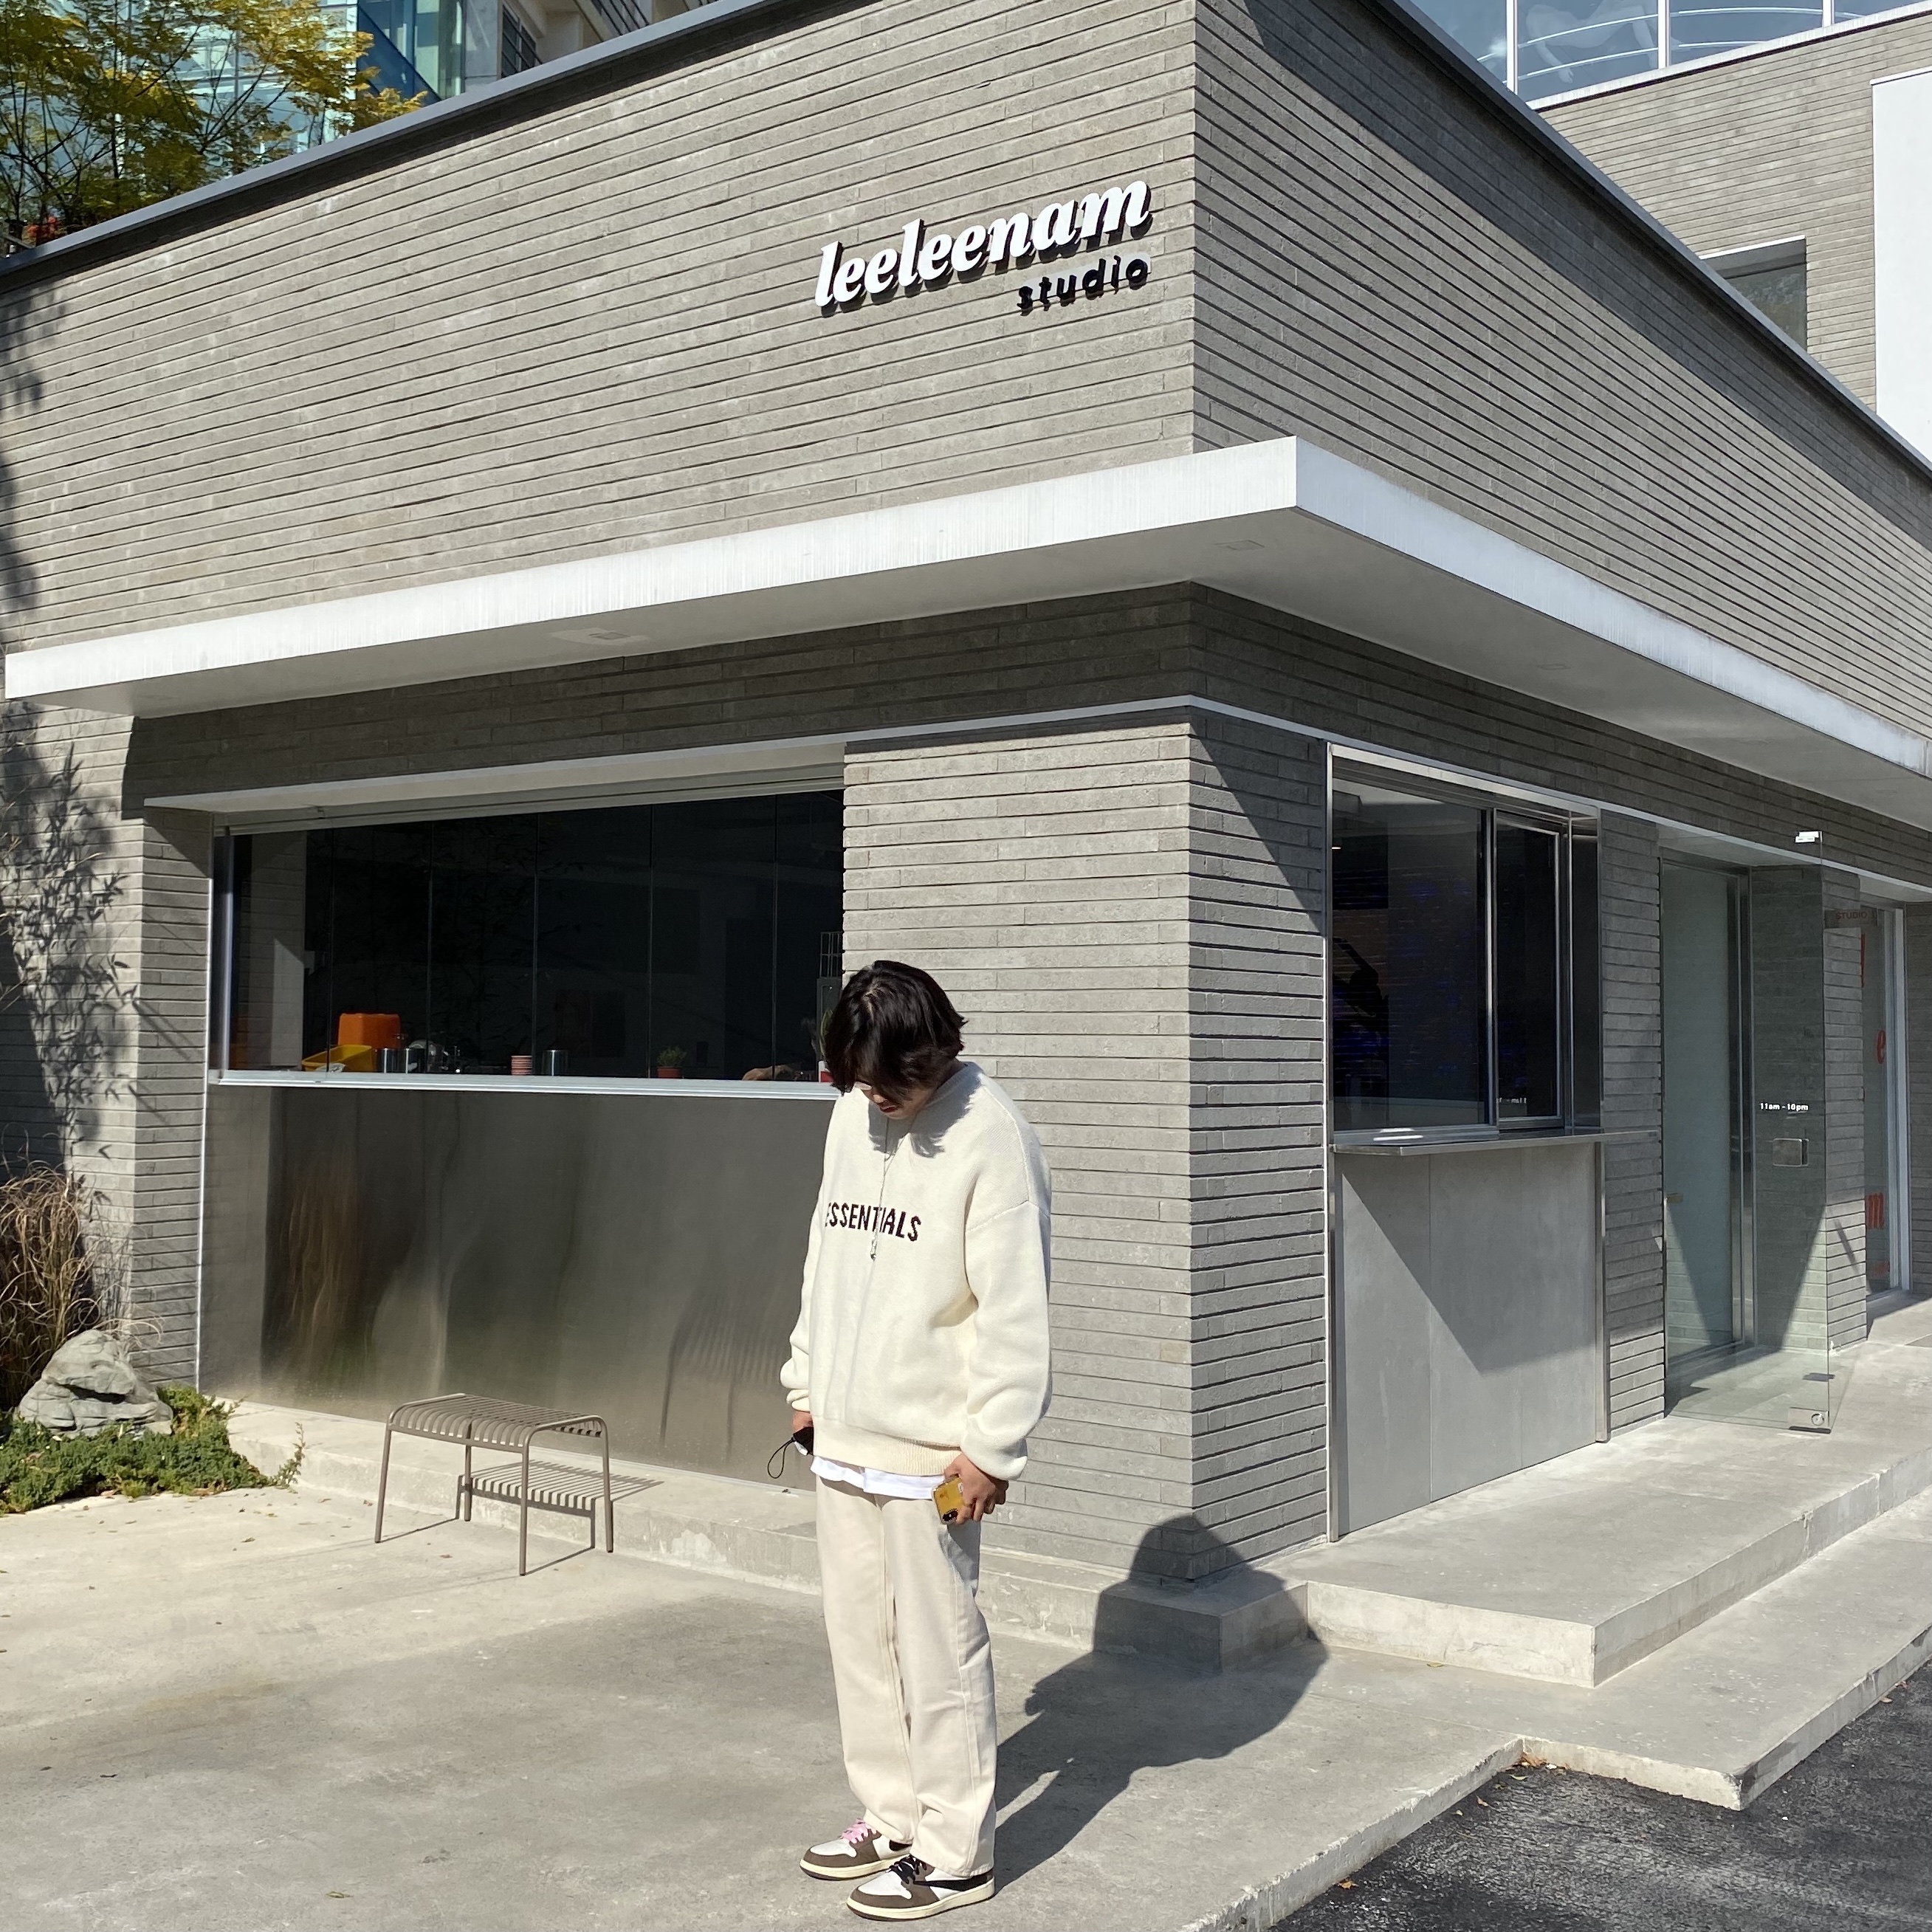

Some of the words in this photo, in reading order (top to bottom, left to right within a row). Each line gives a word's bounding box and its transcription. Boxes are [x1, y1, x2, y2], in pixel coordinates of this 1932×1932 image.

[814, 179, 1151, 309] leeleenam
[1017, 254, 1149, 316] studio
[1760, 1102, 1781, 1110] 11am
[1787, 1103, 1809, 1112] 10pm
[825, 1201, 922, 1242] SSENTIALS
